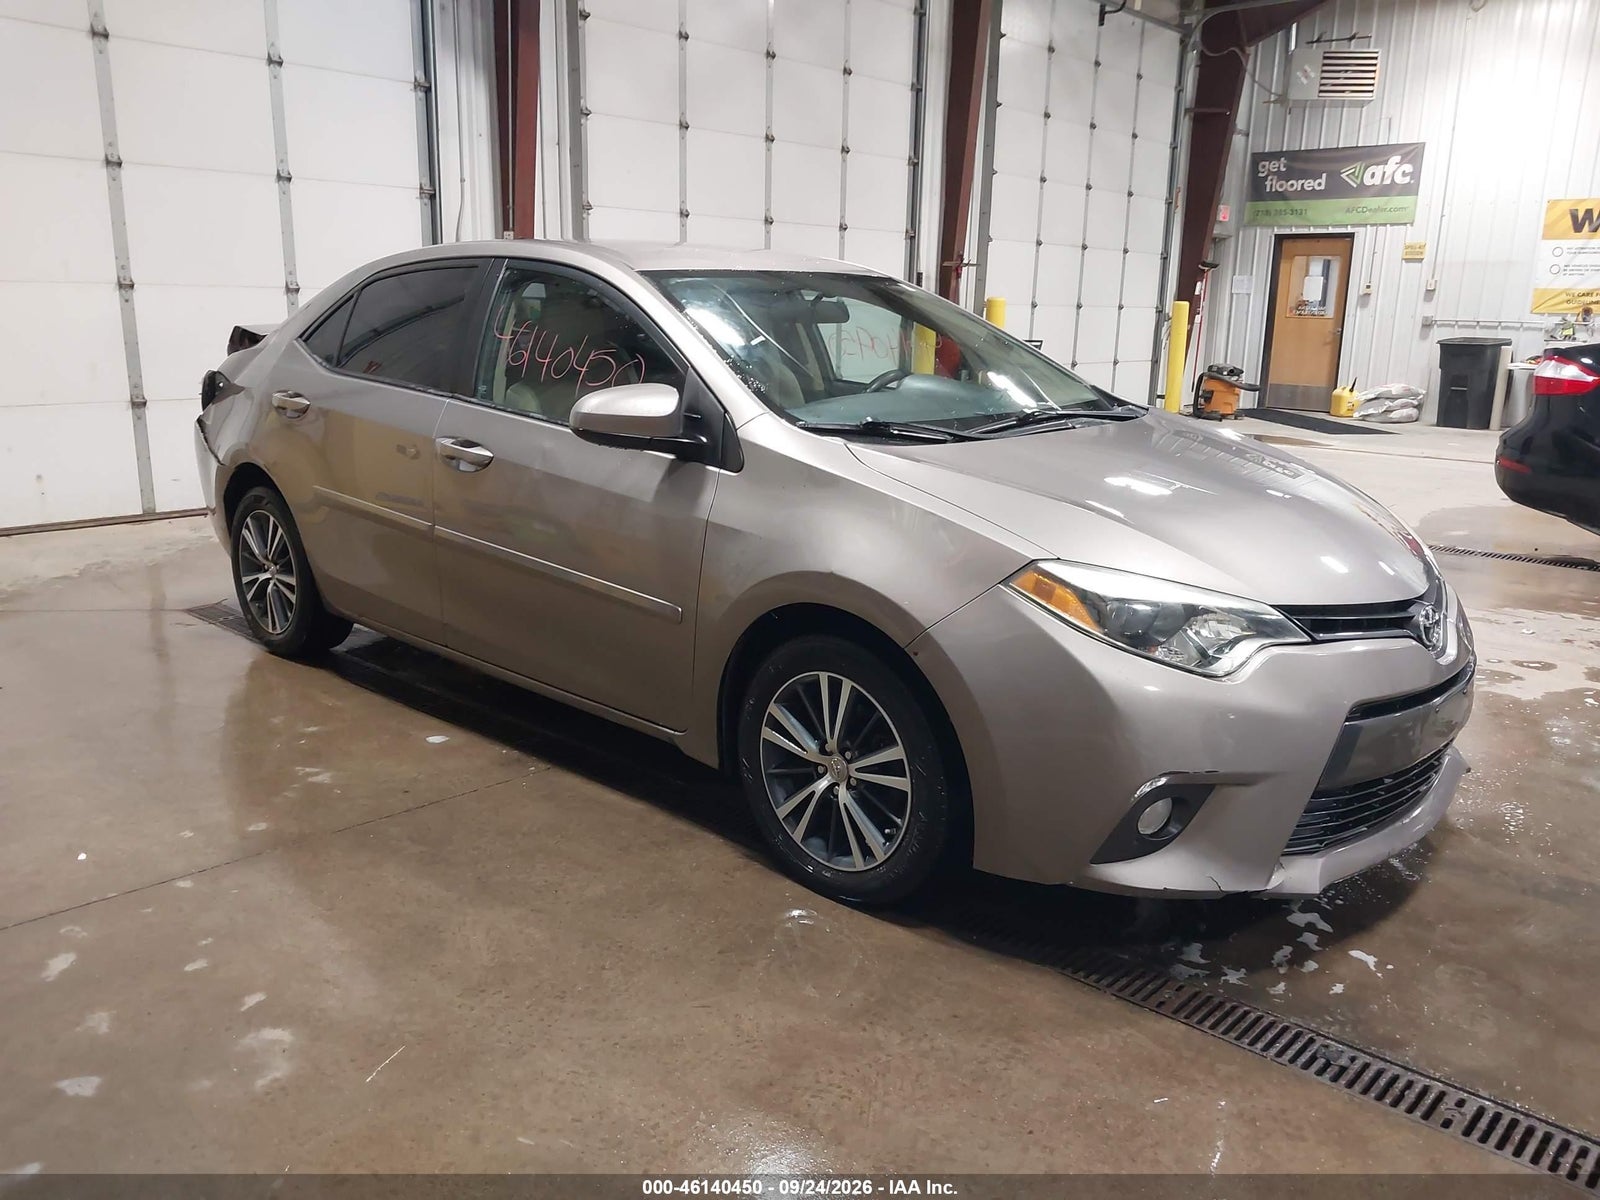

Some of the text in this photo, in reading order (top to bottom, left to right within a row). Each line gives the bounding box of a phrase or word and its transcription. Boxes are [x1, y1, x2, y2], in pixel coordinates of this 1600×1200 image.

[1257, 157, 1287, 177] get
[1264, 173, 1327, 192] floored
[493, 304, 646, 398] 46140450
